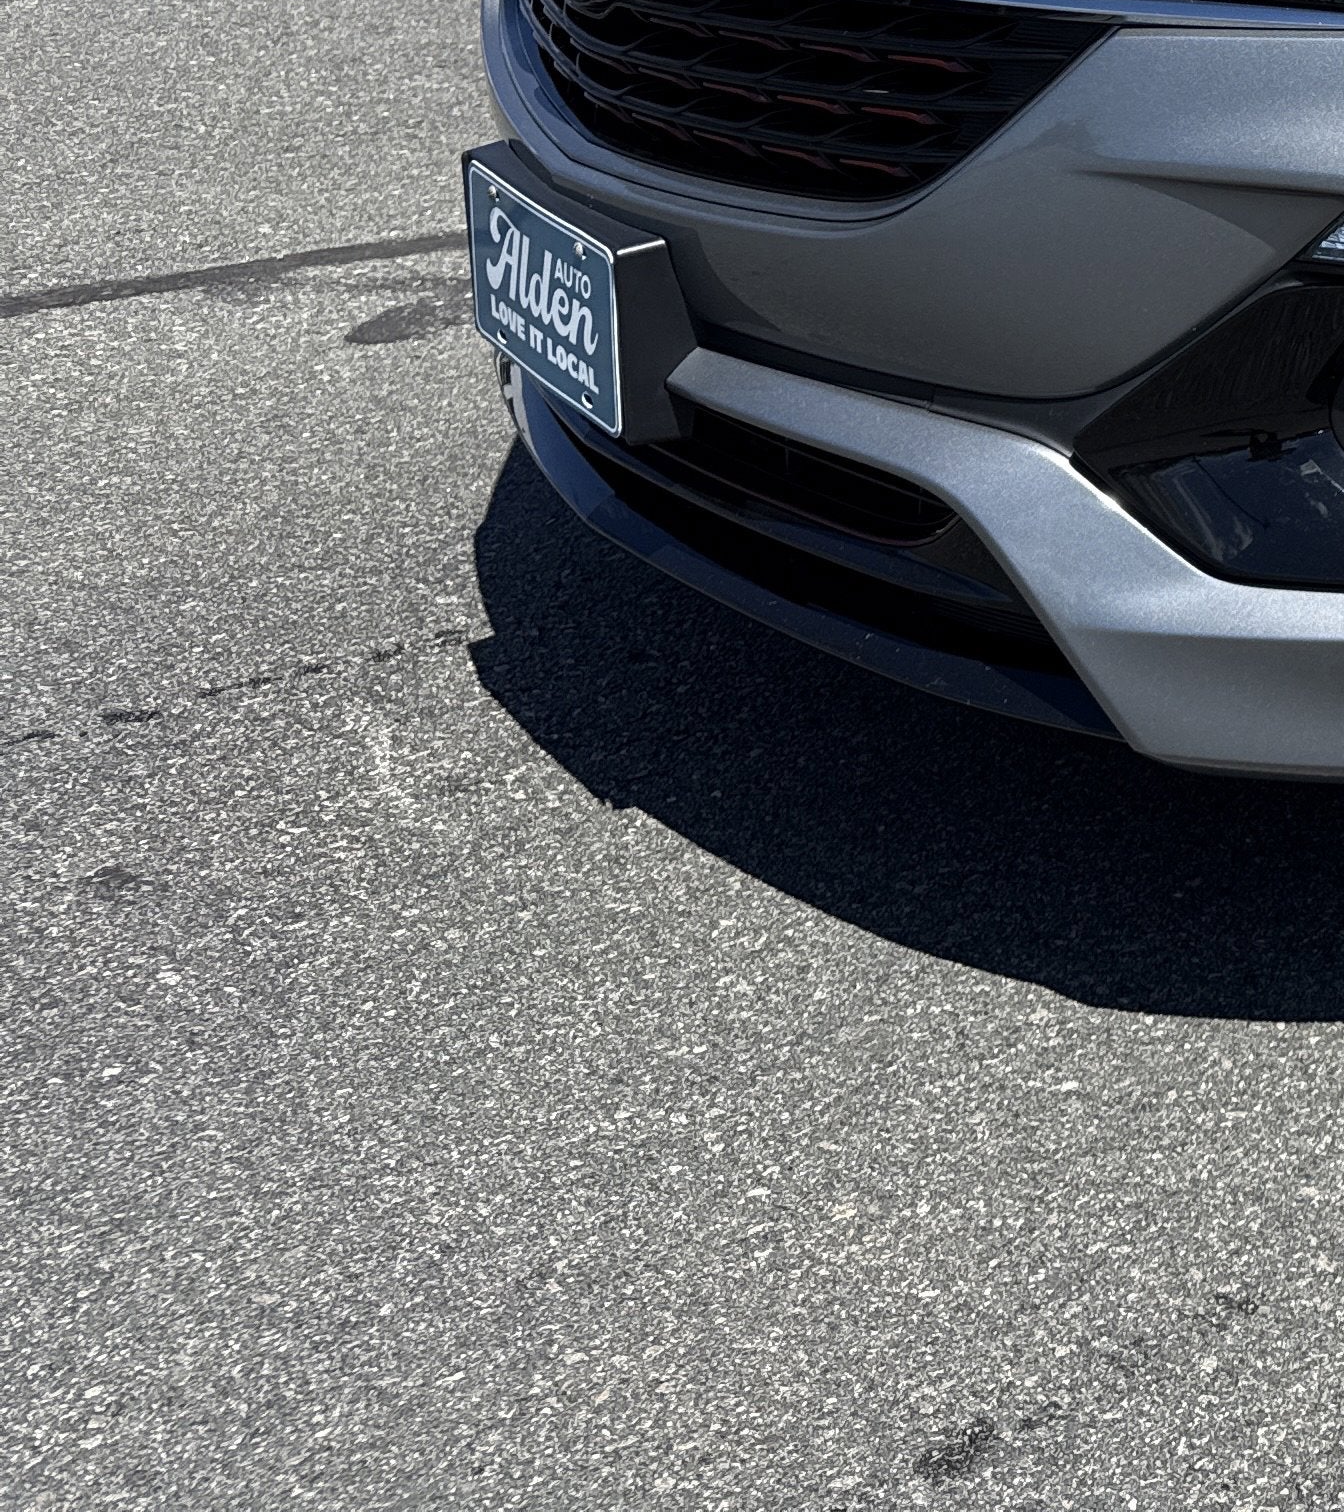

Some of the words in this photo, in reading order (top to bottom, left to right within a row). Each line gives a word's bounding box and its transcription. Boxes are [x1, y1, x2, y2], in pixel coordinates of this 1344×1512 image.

[486, 207, 598, 355] Alden
[554, 258, 591, 299] AUTO
[490, 294, 526, 341] LOVE
[529, 324, 543, 354] IT
[547, 337, 599, 395] LOCAL
